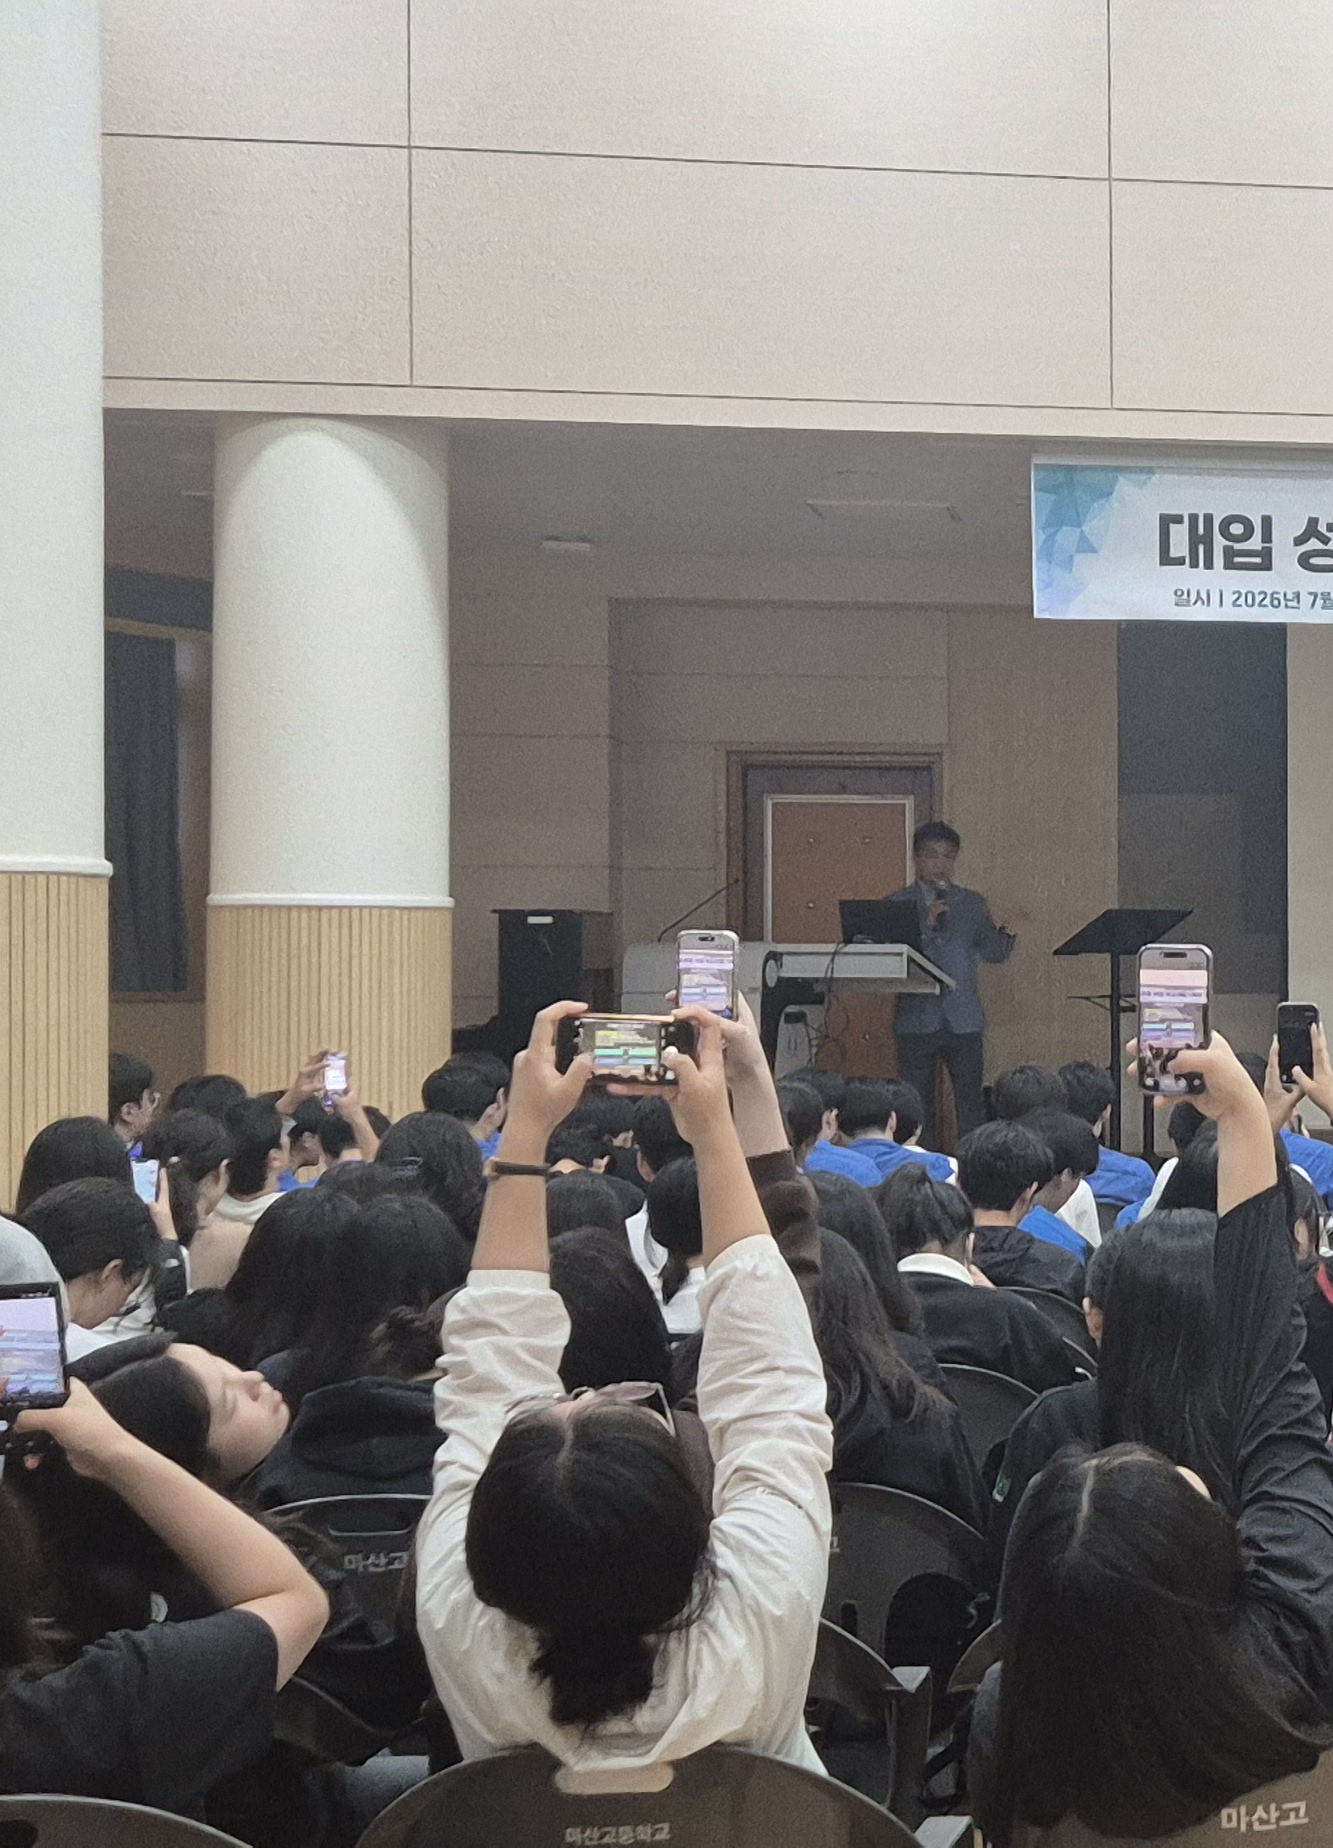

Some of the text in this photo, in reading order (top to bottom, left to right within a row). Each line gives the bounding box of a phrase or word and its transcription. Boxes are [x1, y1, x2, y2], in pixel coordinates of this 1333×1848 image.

[1159, 513, 1273, 571] 대입
[1173, 588, 1211, 608] 일시
[1231, 590, 1300, 610] 2026년
[343, 1551, 410, 1575] 마산고
[1220, 1800, 1309, 1833] 마산고
